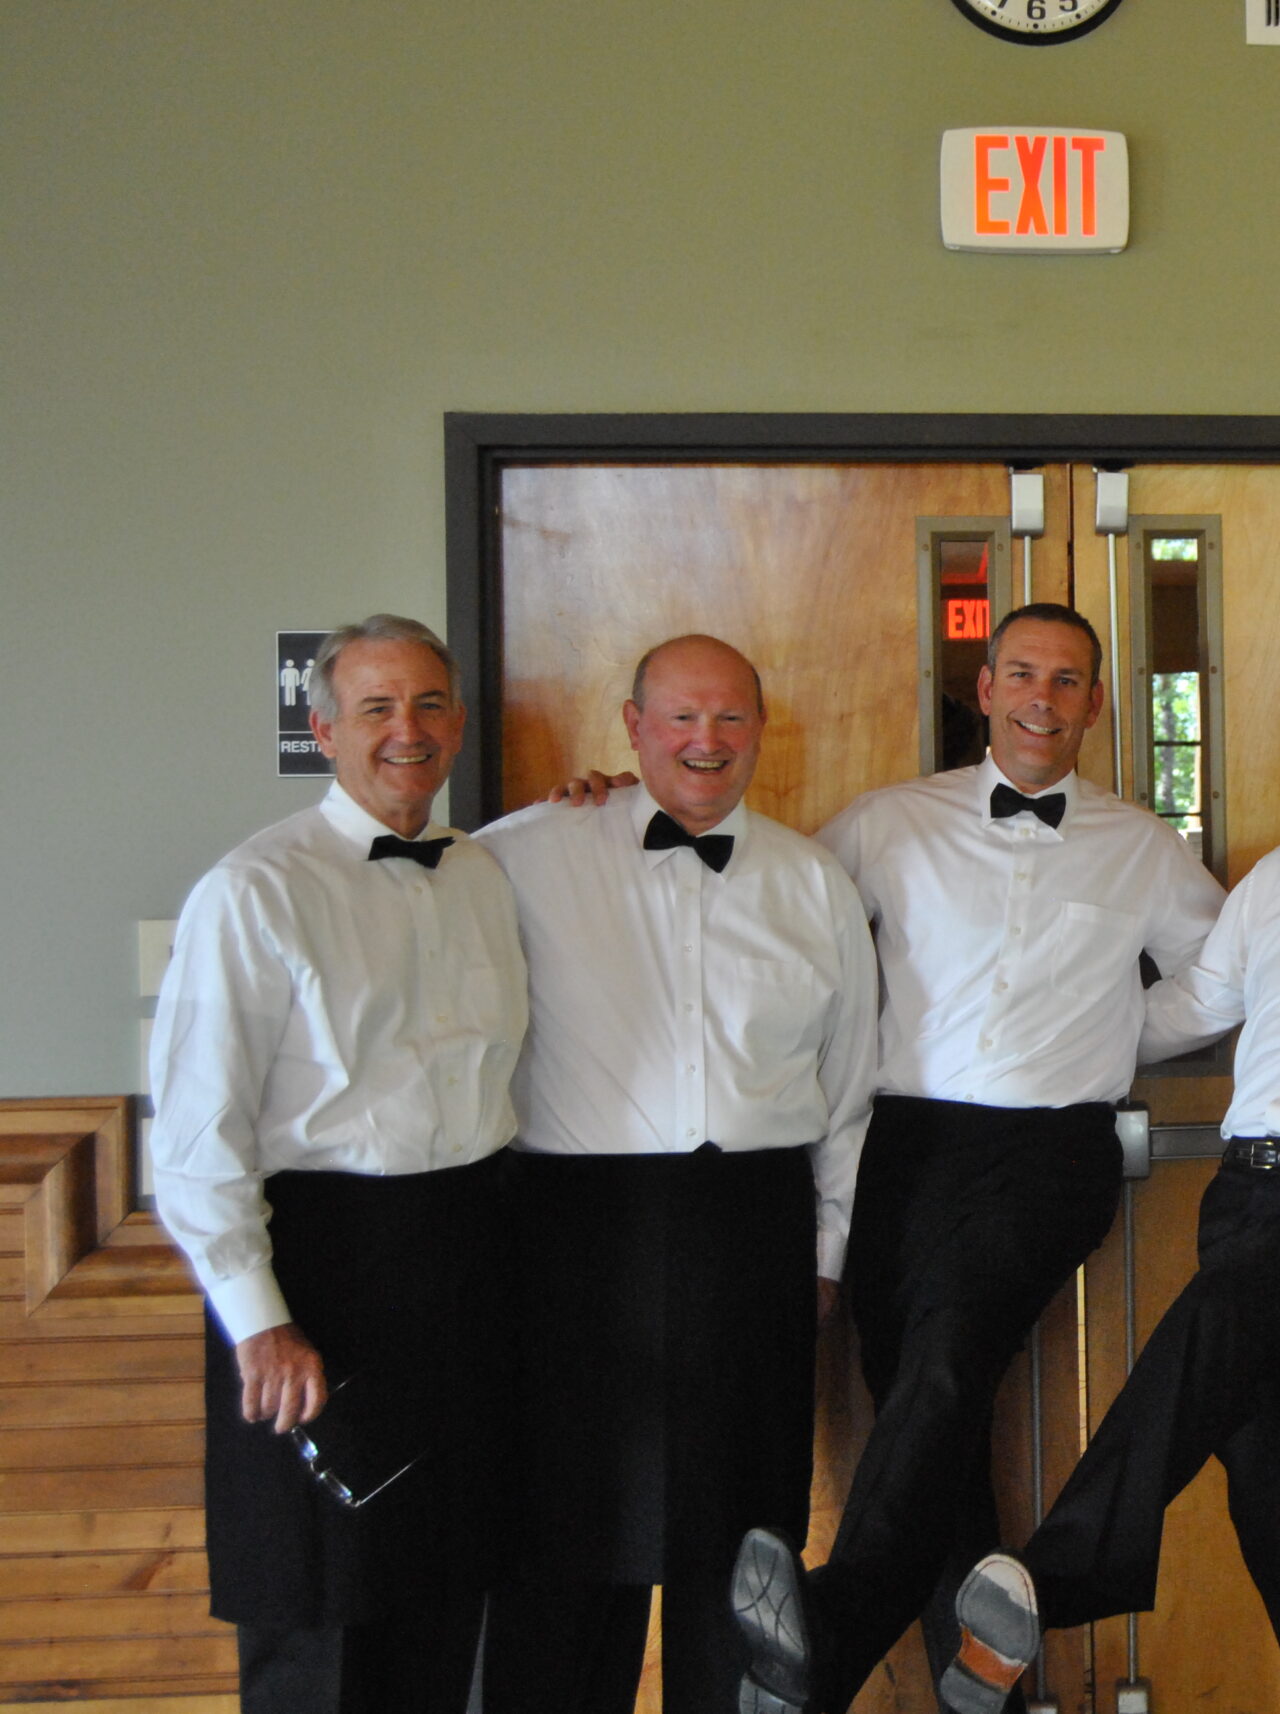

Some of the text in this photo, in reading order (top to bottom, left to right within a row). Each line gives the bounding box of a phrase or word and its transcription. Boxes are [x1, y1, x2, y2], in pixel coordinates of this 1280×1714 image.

[1027, 0, 1046, 20] 6
[974, 135, 1105, 236] EXIT
[280, 740, 322, 753] REST
